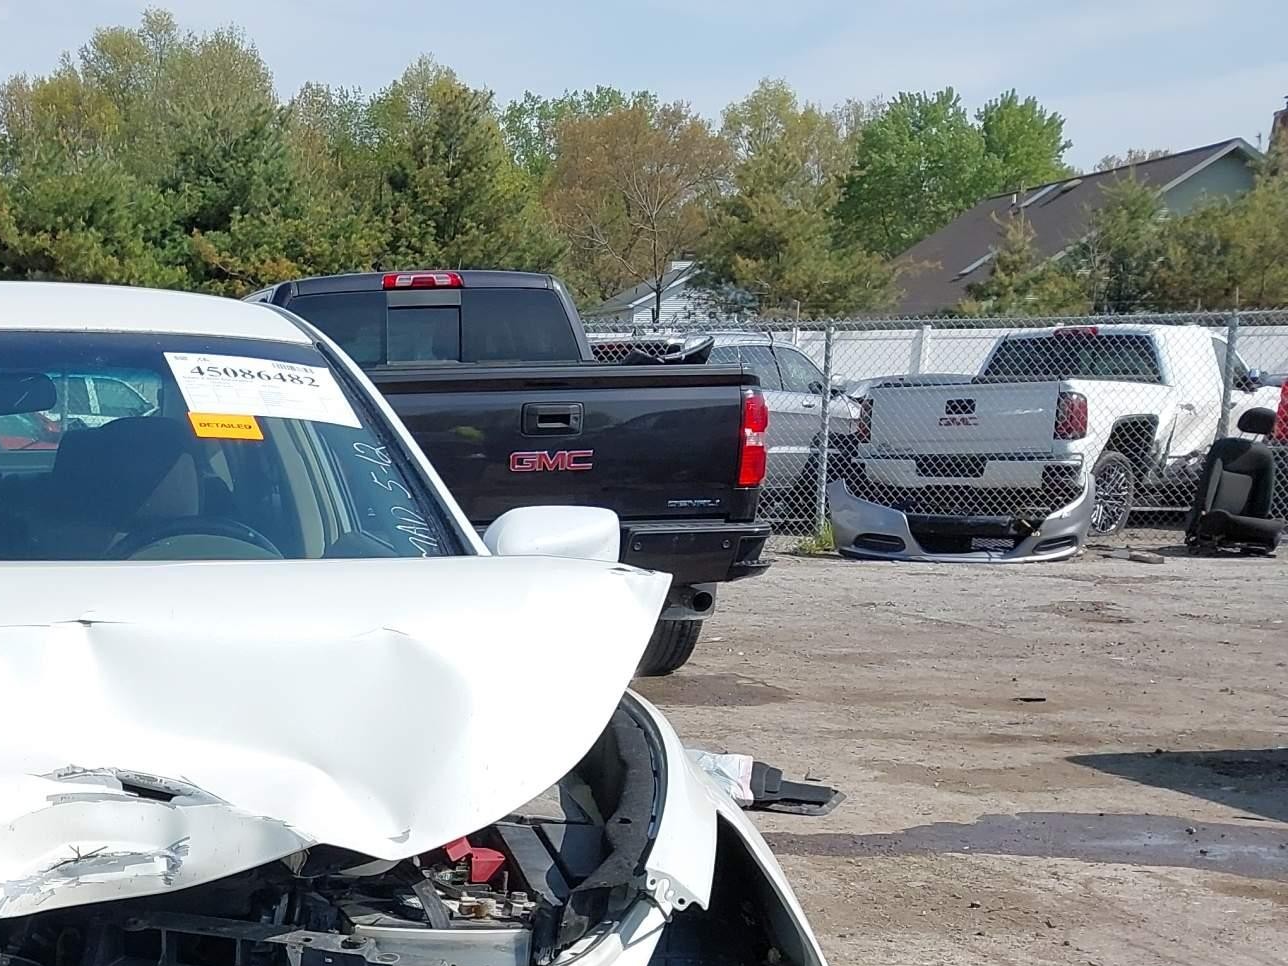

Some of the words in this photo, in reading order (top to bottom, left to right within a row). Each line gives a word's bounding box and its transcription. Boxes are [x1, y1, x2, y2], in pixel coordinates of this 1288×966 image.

[189, 365, 320, 388] 45086482
[198, 421, 253, 431] DETAILED
[510, 449, 593, 472] GMC
